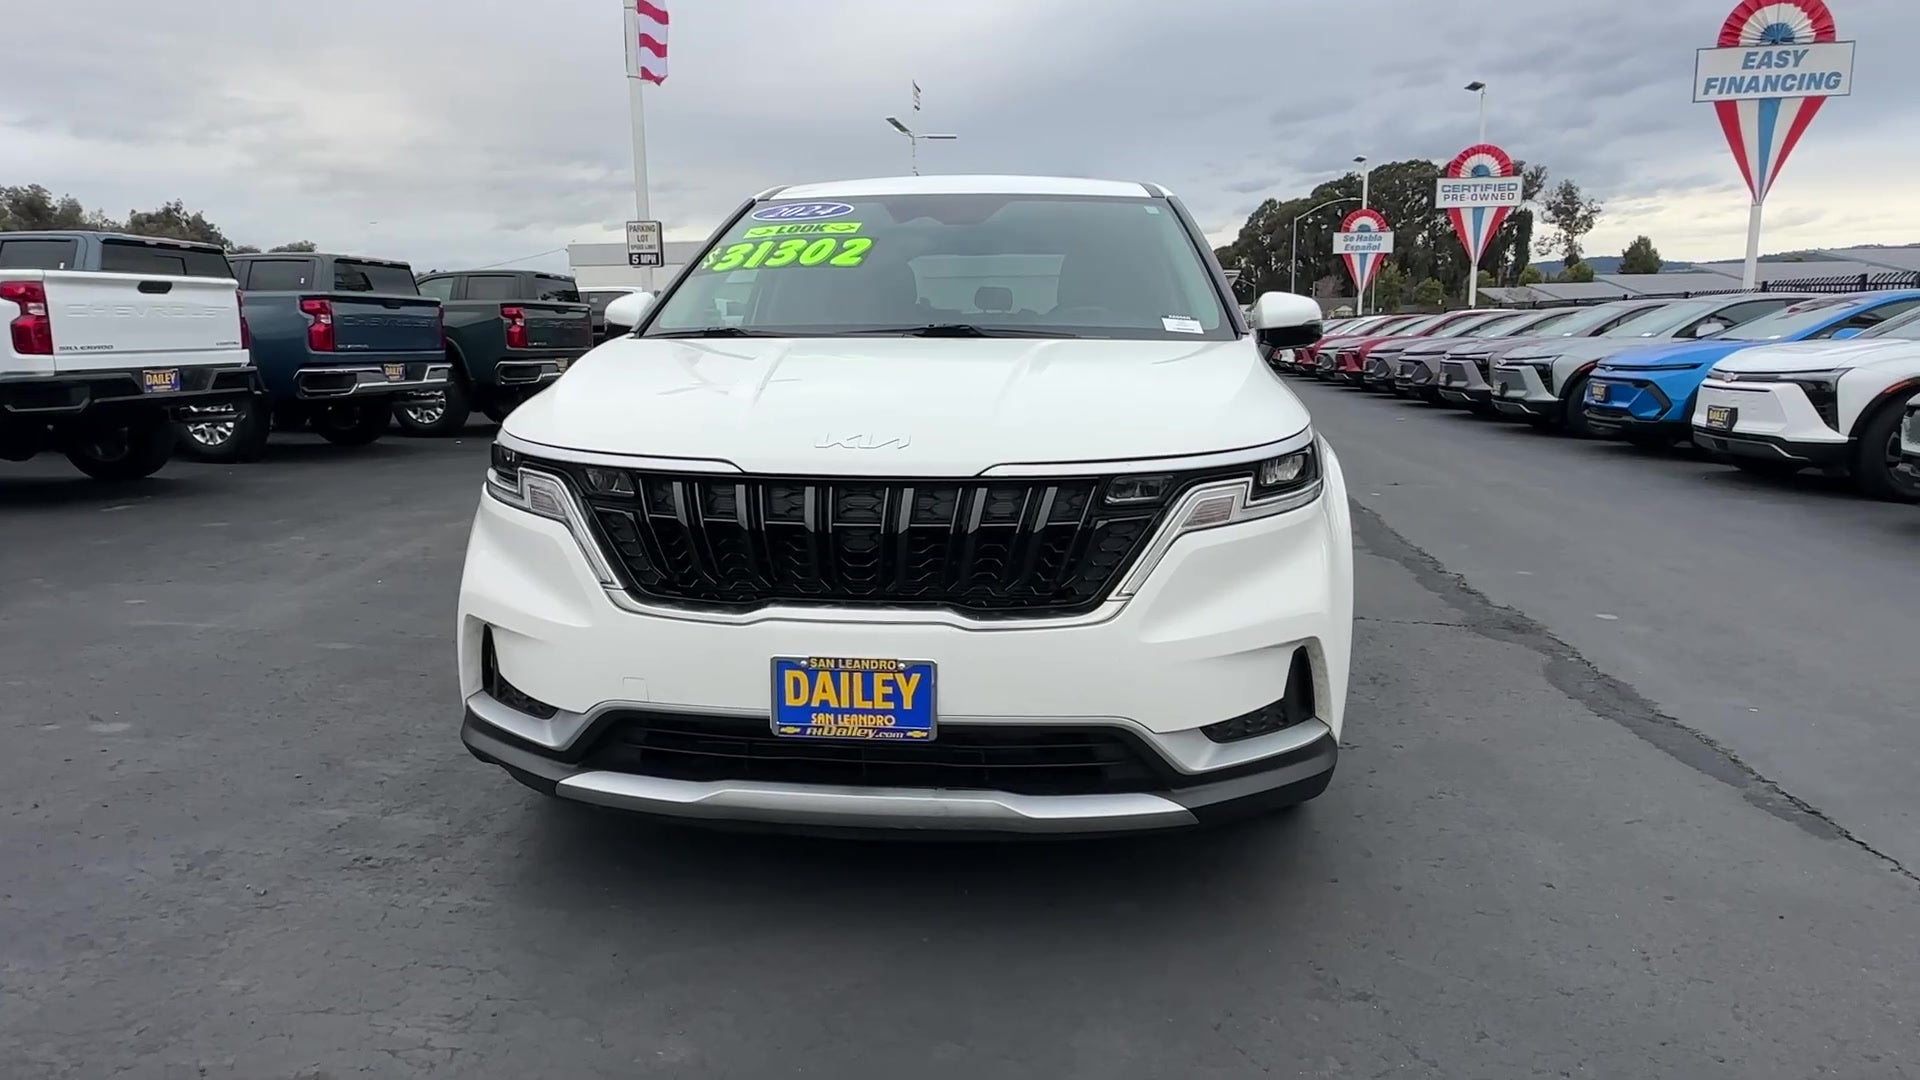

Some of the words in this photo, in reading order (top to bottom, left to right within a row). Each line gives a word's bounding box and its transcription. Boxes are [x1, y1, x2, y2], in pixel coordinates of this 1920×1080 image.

[1741, 49, 1809, 70] EASY
[1703, 72, 1842, 95] FINANCING
[1441, 183, 1518, 193] CERTIFIED
[1443, 192, 1515, 202] PRE-OWNED
[766, 203, 838, 219] 2024
[629, 224, 656, 233] PARKING
[774, 224, 830, 235] LOOK
[637, 234, 649, 243] LOT
[1343, 234, 1355, 242] Se
[1355, 234, 1383, 242] Habla
[1344, 243, 1381, 252] Español
[631, 254, 640, 264] 5
[641, 254, 657, 264] MPH
[702, 237, 873, 272] $31302
[145, 372, 176, 386] DAILEY
[814, 432, 912, 449] KIA
[810, 658, 835, 669] SAN
[838, 658, 897, 670] LEANDRO
[784, 669, 921, 710] DAILEY
[810, 712, 834, 726] SAN
[837, 713, 896, 727] LEANDRO
